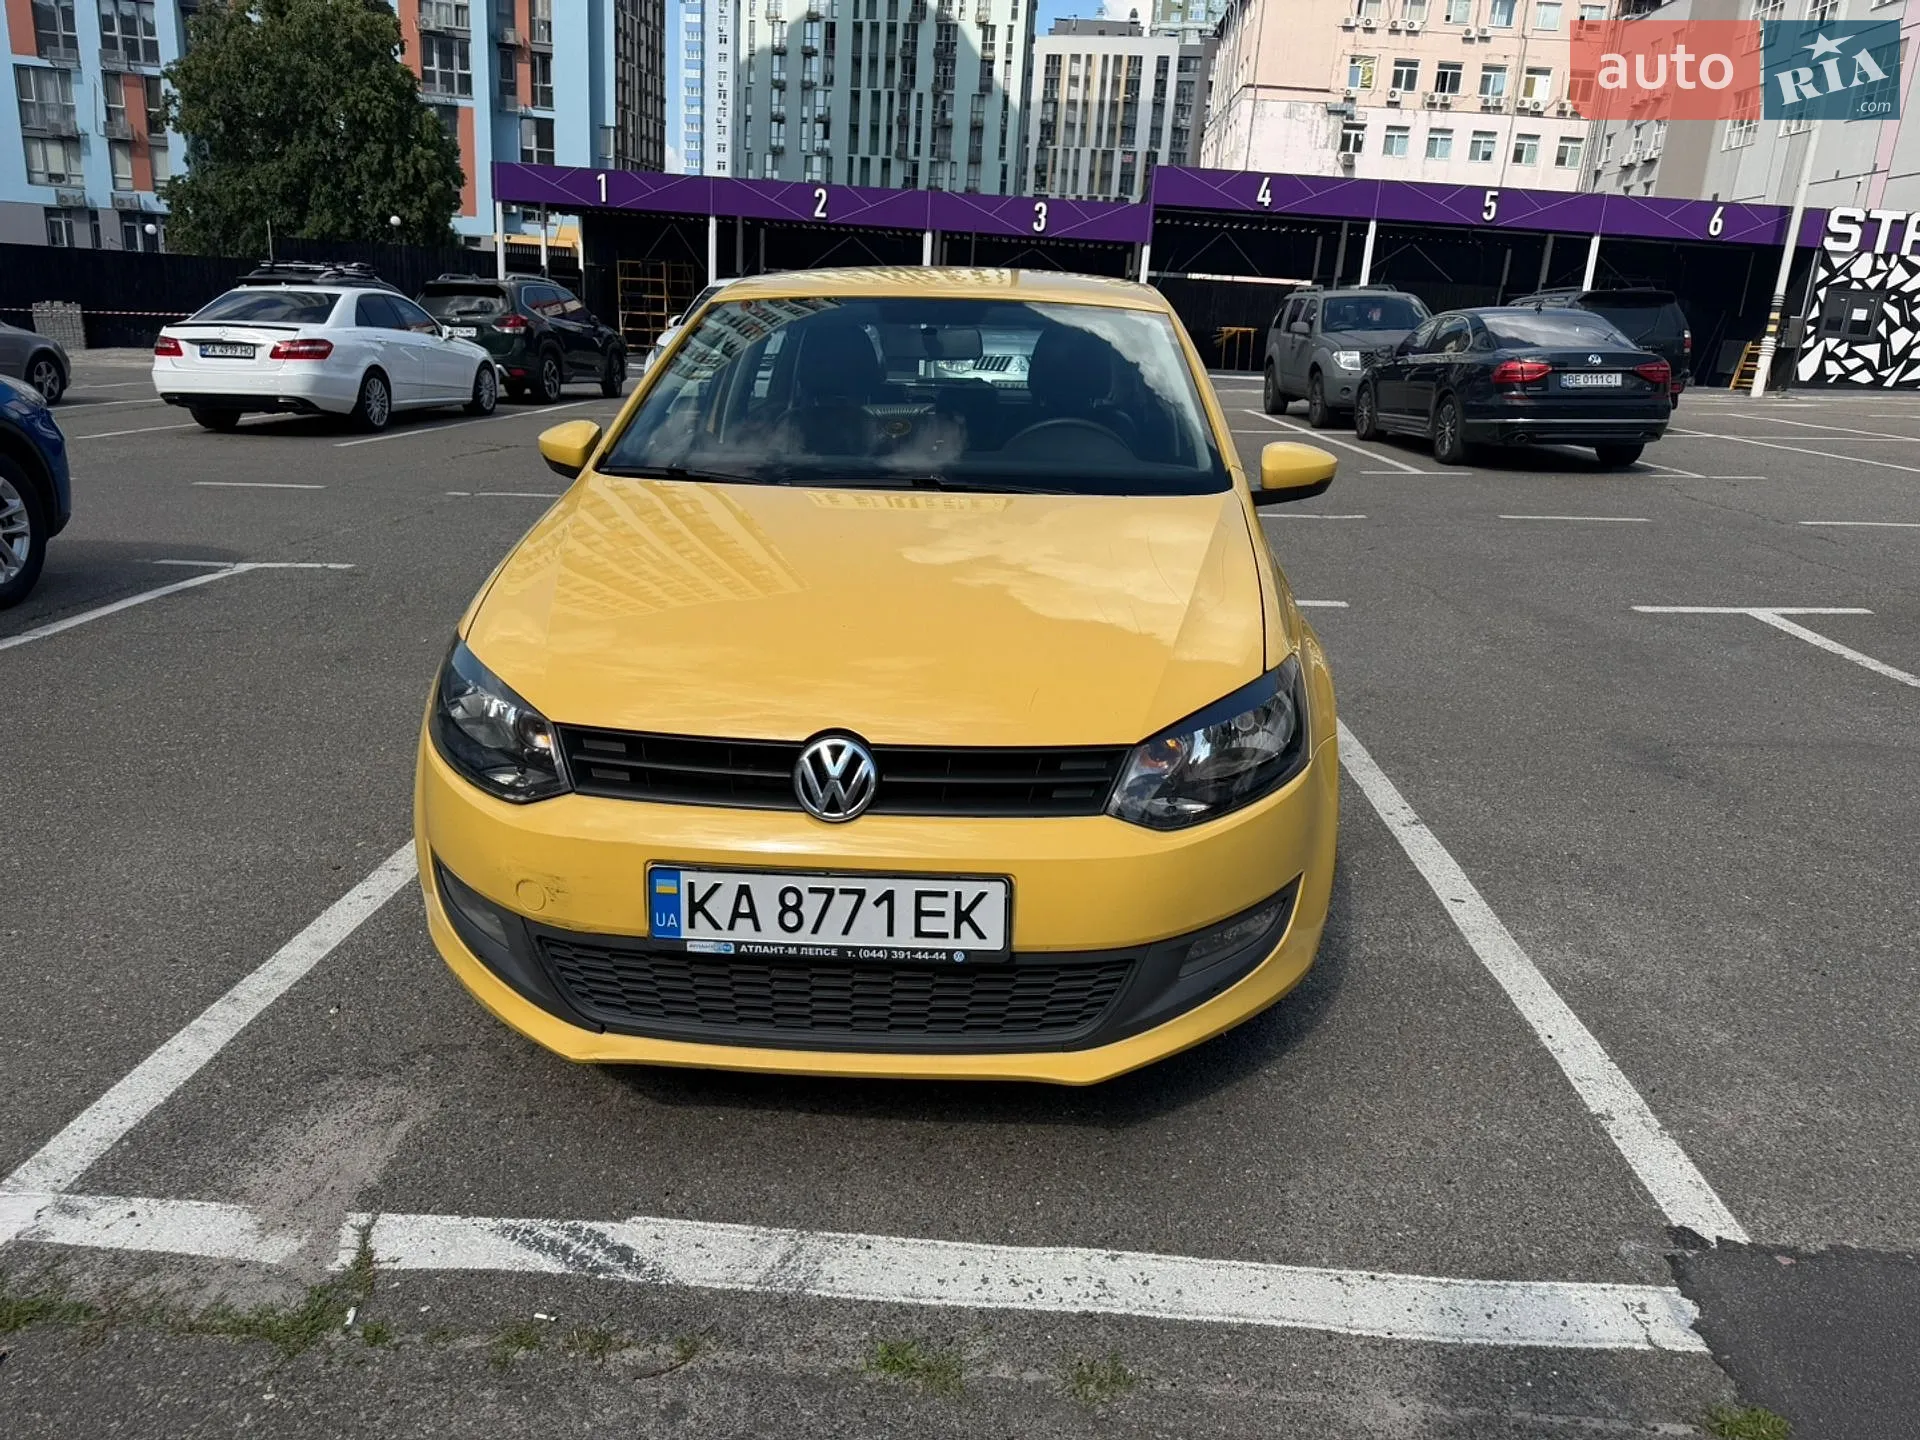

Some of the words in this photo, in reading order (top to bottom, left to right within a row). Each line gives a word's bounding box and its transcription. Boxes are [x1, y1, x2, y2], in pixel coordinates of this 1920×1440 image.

[597, 173, 607, 202] 1
[1256, 177, 1272, 207] 4
[814, 188, 827, 218] 2
[1033, 202, 1048, 232] 3
[1482, 190, 1499, 221] 5
[1708, 206, 1725, 236] 6
[1567, 374, 1581, 385] BE
[1583, 374, 1604, 384] 0111
[655, 912, 679, 928] UA
[687, 880, 762, 933] KA
[777, 885, 895, 938] 8771
[914, 889, 988, 940] EK
[739, 944, 798, 956] АТЛАНТ-М
[799, 946, 839, 957] ЛЕПСЕ
[858, 948, 888, 960] (044)
[890, 949, 947, 961] 391-44-44
